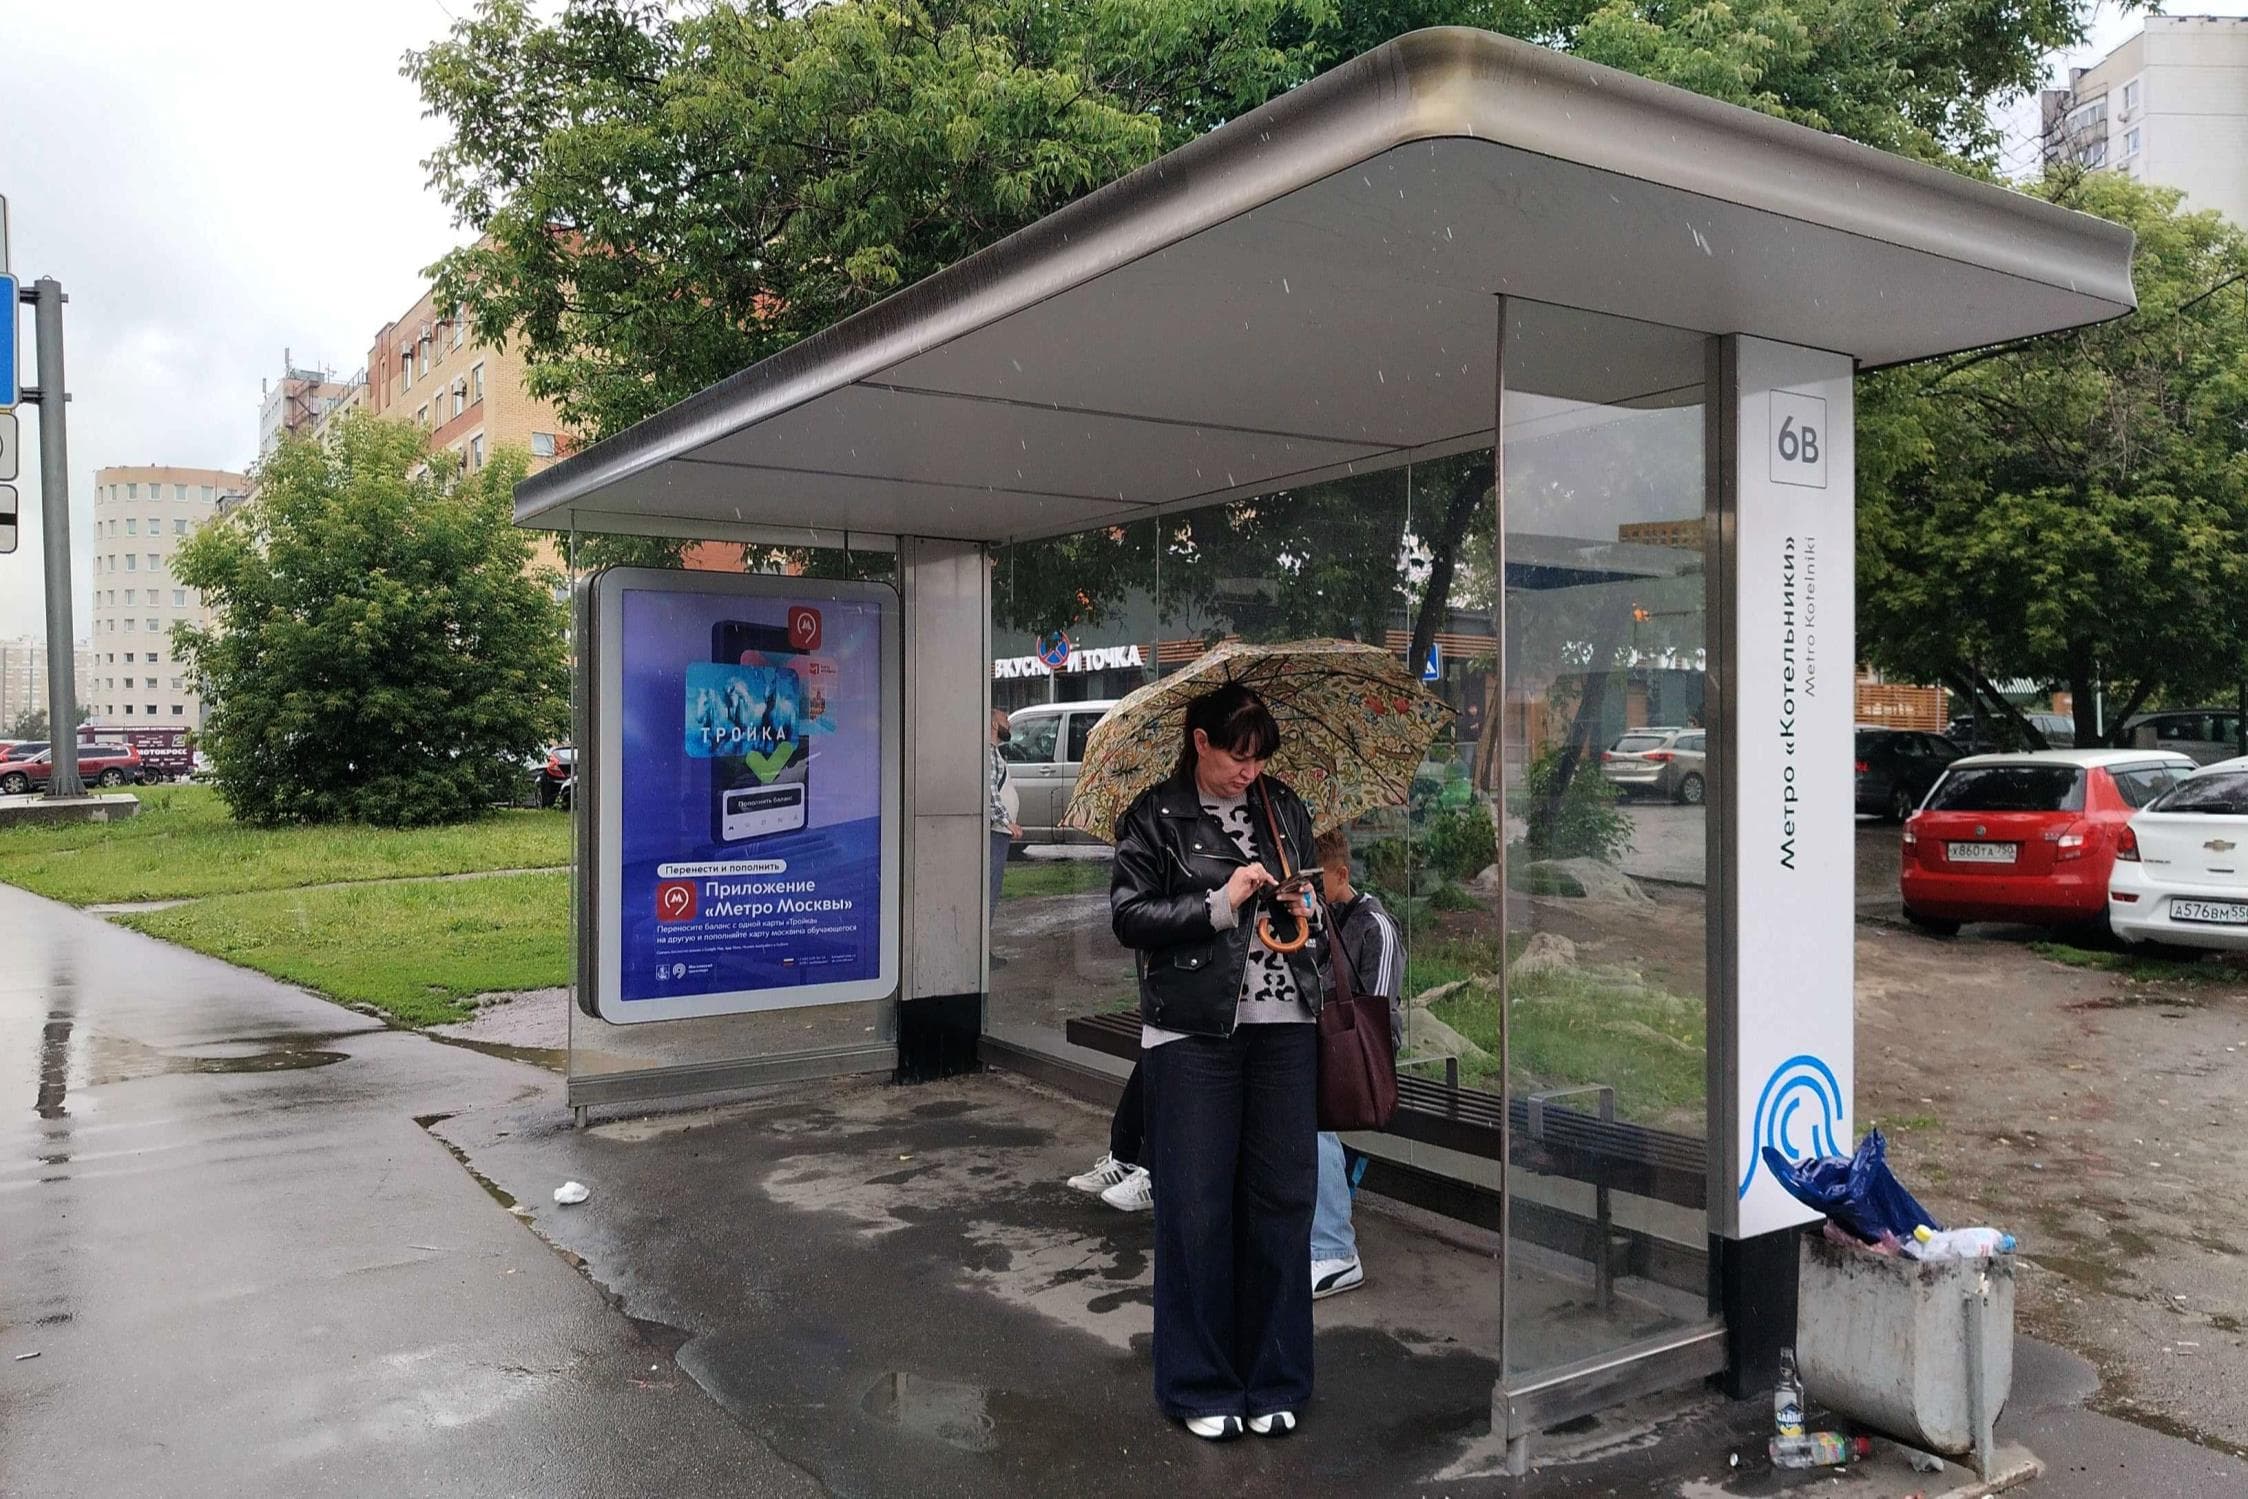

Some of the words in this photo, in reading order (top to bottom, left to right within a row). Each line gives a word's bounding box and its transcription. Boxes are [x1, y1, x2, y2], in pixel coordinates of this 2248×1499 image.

[1804, 536, 1815, 628] Kotelniki
[1780, 536, 1795, 755] «Котельники»
[1067, 651, 1082, 673] И
[1082, 645, 1144, 672] ТОЧКА
[1804, 634, 1815, 697] Metro
[700, 722, 786, 743] ТРОЙКА
[1780, 766, 1798, 870] Метро
[665, 865, 719, 876] Перенести
[729, 863, 780, 873] пополнить
[706, 880, 815, 898] Приложение
[705, 901, 772, 917] «Метро
[777, 898, 853, 914] Москвы»
[656, 936, 666, 944] на
[667, 935, 696, 944] другую
[704, 931, 748, 941] пополняйте
[749, 929, 770, 940] карту
[771, 927, 805, 937] москвича
[657, 923, 703, 934] Переносите
[704, 921, 731, 931] баланс
[738, 920, 761, 930] одной
[762, 920, 784, 929] карты
